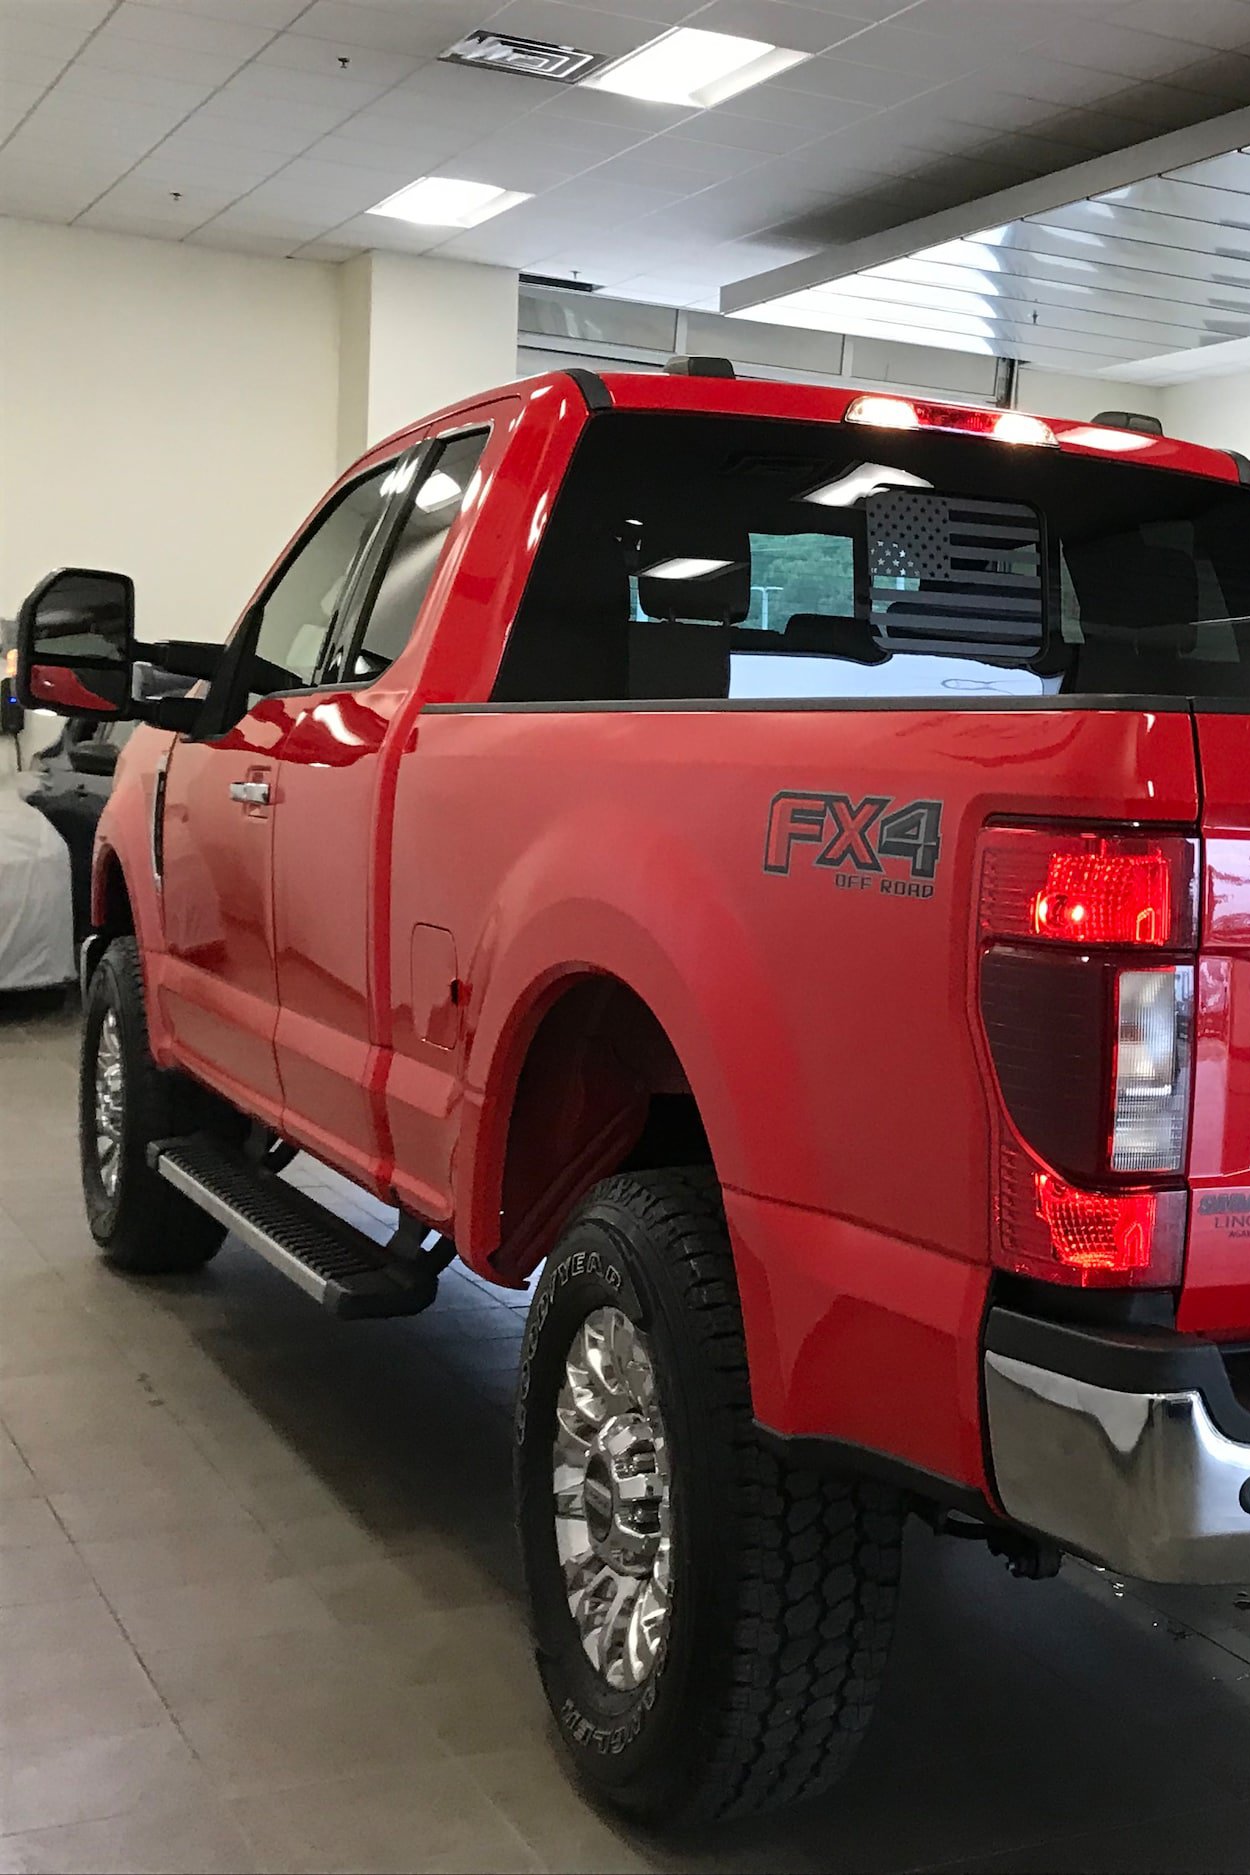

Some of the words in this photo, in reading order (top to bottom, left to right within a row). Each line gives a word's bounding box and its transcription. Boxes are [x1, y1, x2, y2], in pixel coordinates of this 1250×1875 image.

[762, 789, 944, 879] FX4
[835, 873, 873, 890] OFF
[880, 879, 935, 899] ROAD
